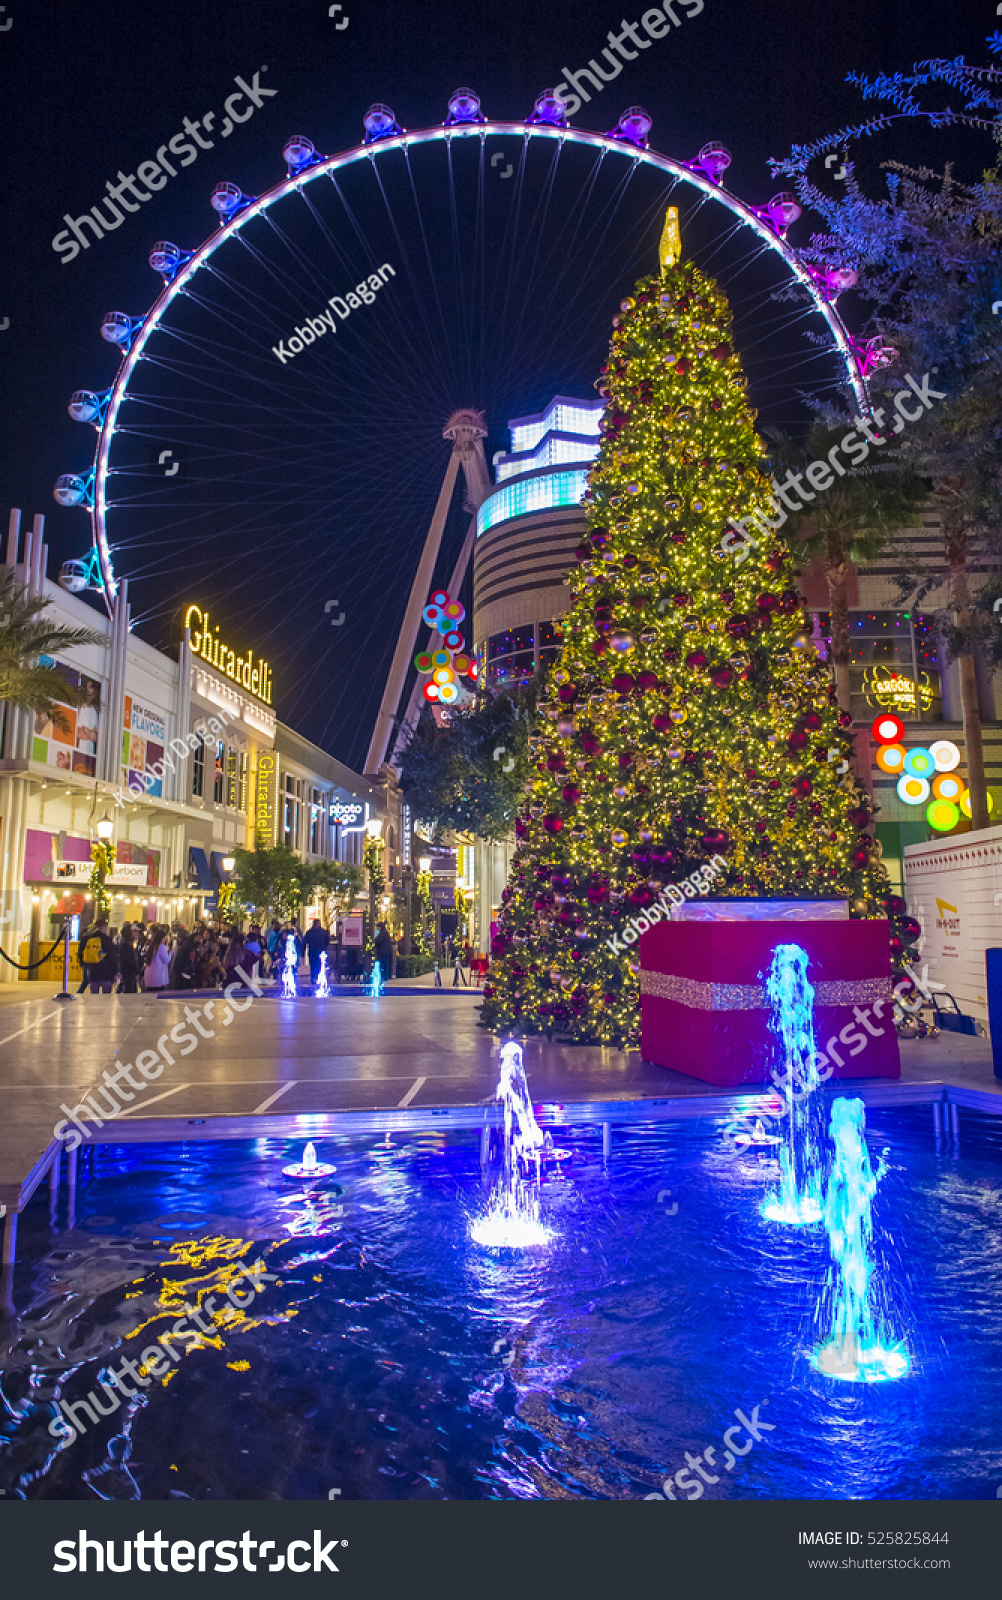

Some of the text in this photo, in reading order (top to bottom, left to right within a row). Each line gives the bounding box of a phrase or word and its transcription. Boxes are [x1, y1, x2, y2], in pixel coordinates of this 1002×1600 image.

[185, 605, 273, 705] Ghirardelli
[132, 713, 165, 740] FLAVORS
[257, 755, 275, 844] Ghirardelli
[329, 803, 363, 817] photo
